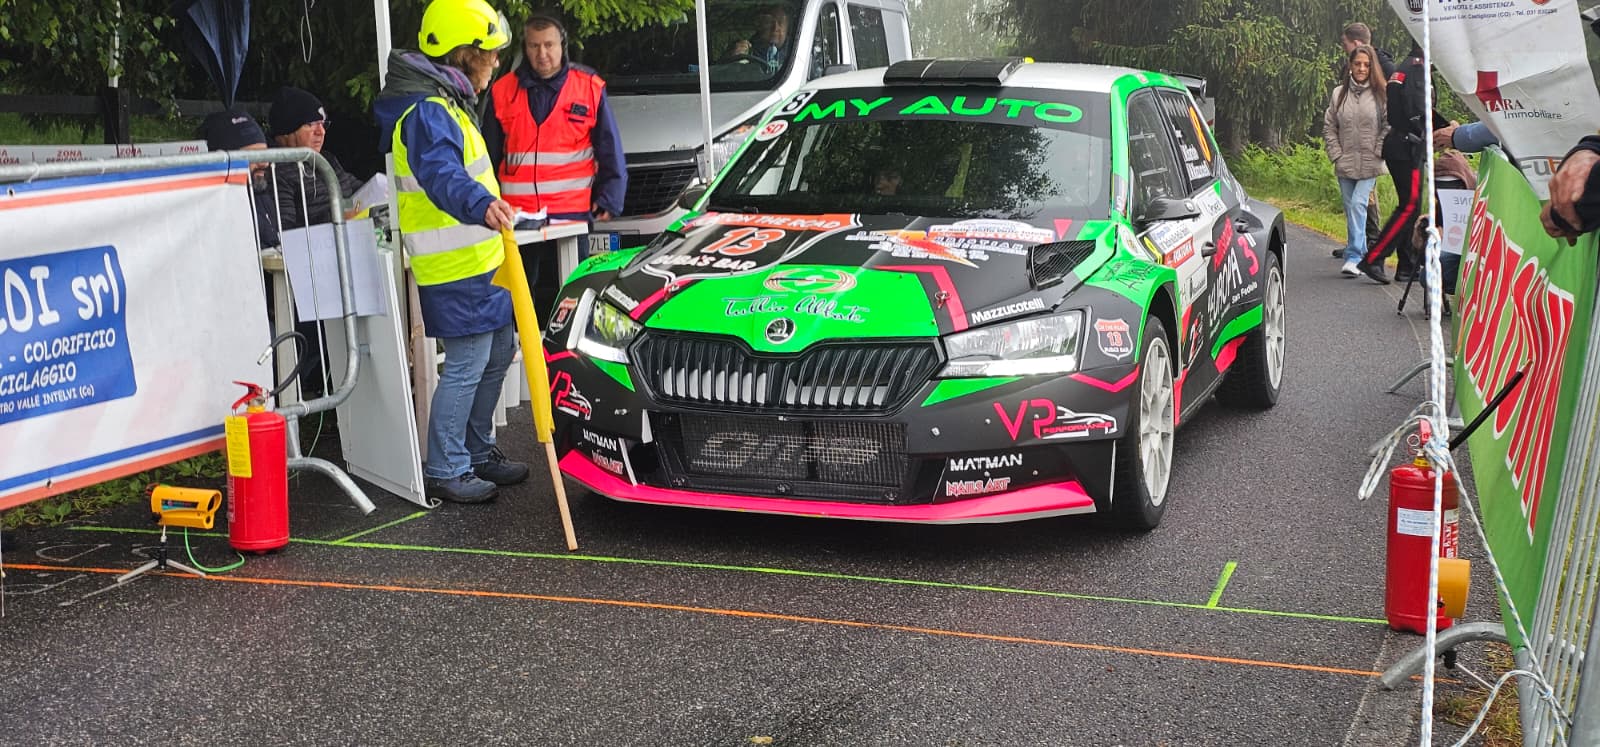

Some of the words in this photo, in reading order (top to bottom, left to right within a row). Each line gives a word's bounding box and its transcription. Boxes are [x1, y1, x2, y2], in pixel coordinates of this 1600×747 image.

[1474, 1, 1515, 10] ASSISTENZA
[793, 97, 894, 122] MY
[899, 95, 1084, 123] AUTO
[1503, 108, 1563, 120] Immobiliare
[57, 150, 82, 158] ZONA
[179, 145, 200, 154] ZONA
[700, 226, 787, 256] 13
[0, 266, 60, 334] DI
[71, 252, 120, 320] srl
[970, 297, 1046, 324] Mazzucotelli
[24, 327, 116, 364] COLORIFICIO
[0, 360, 77, 397] CICLAGGIO
[16, 394, 40, 412] VALLE
[42, 387, 78, 406] INTELVI
[992, 398, 1058, 441] VP
[949, 453, 1023, 472] MATMAN
[945, 479, 984, 497] NAILS
[983, 476, 1012, 493] ART
